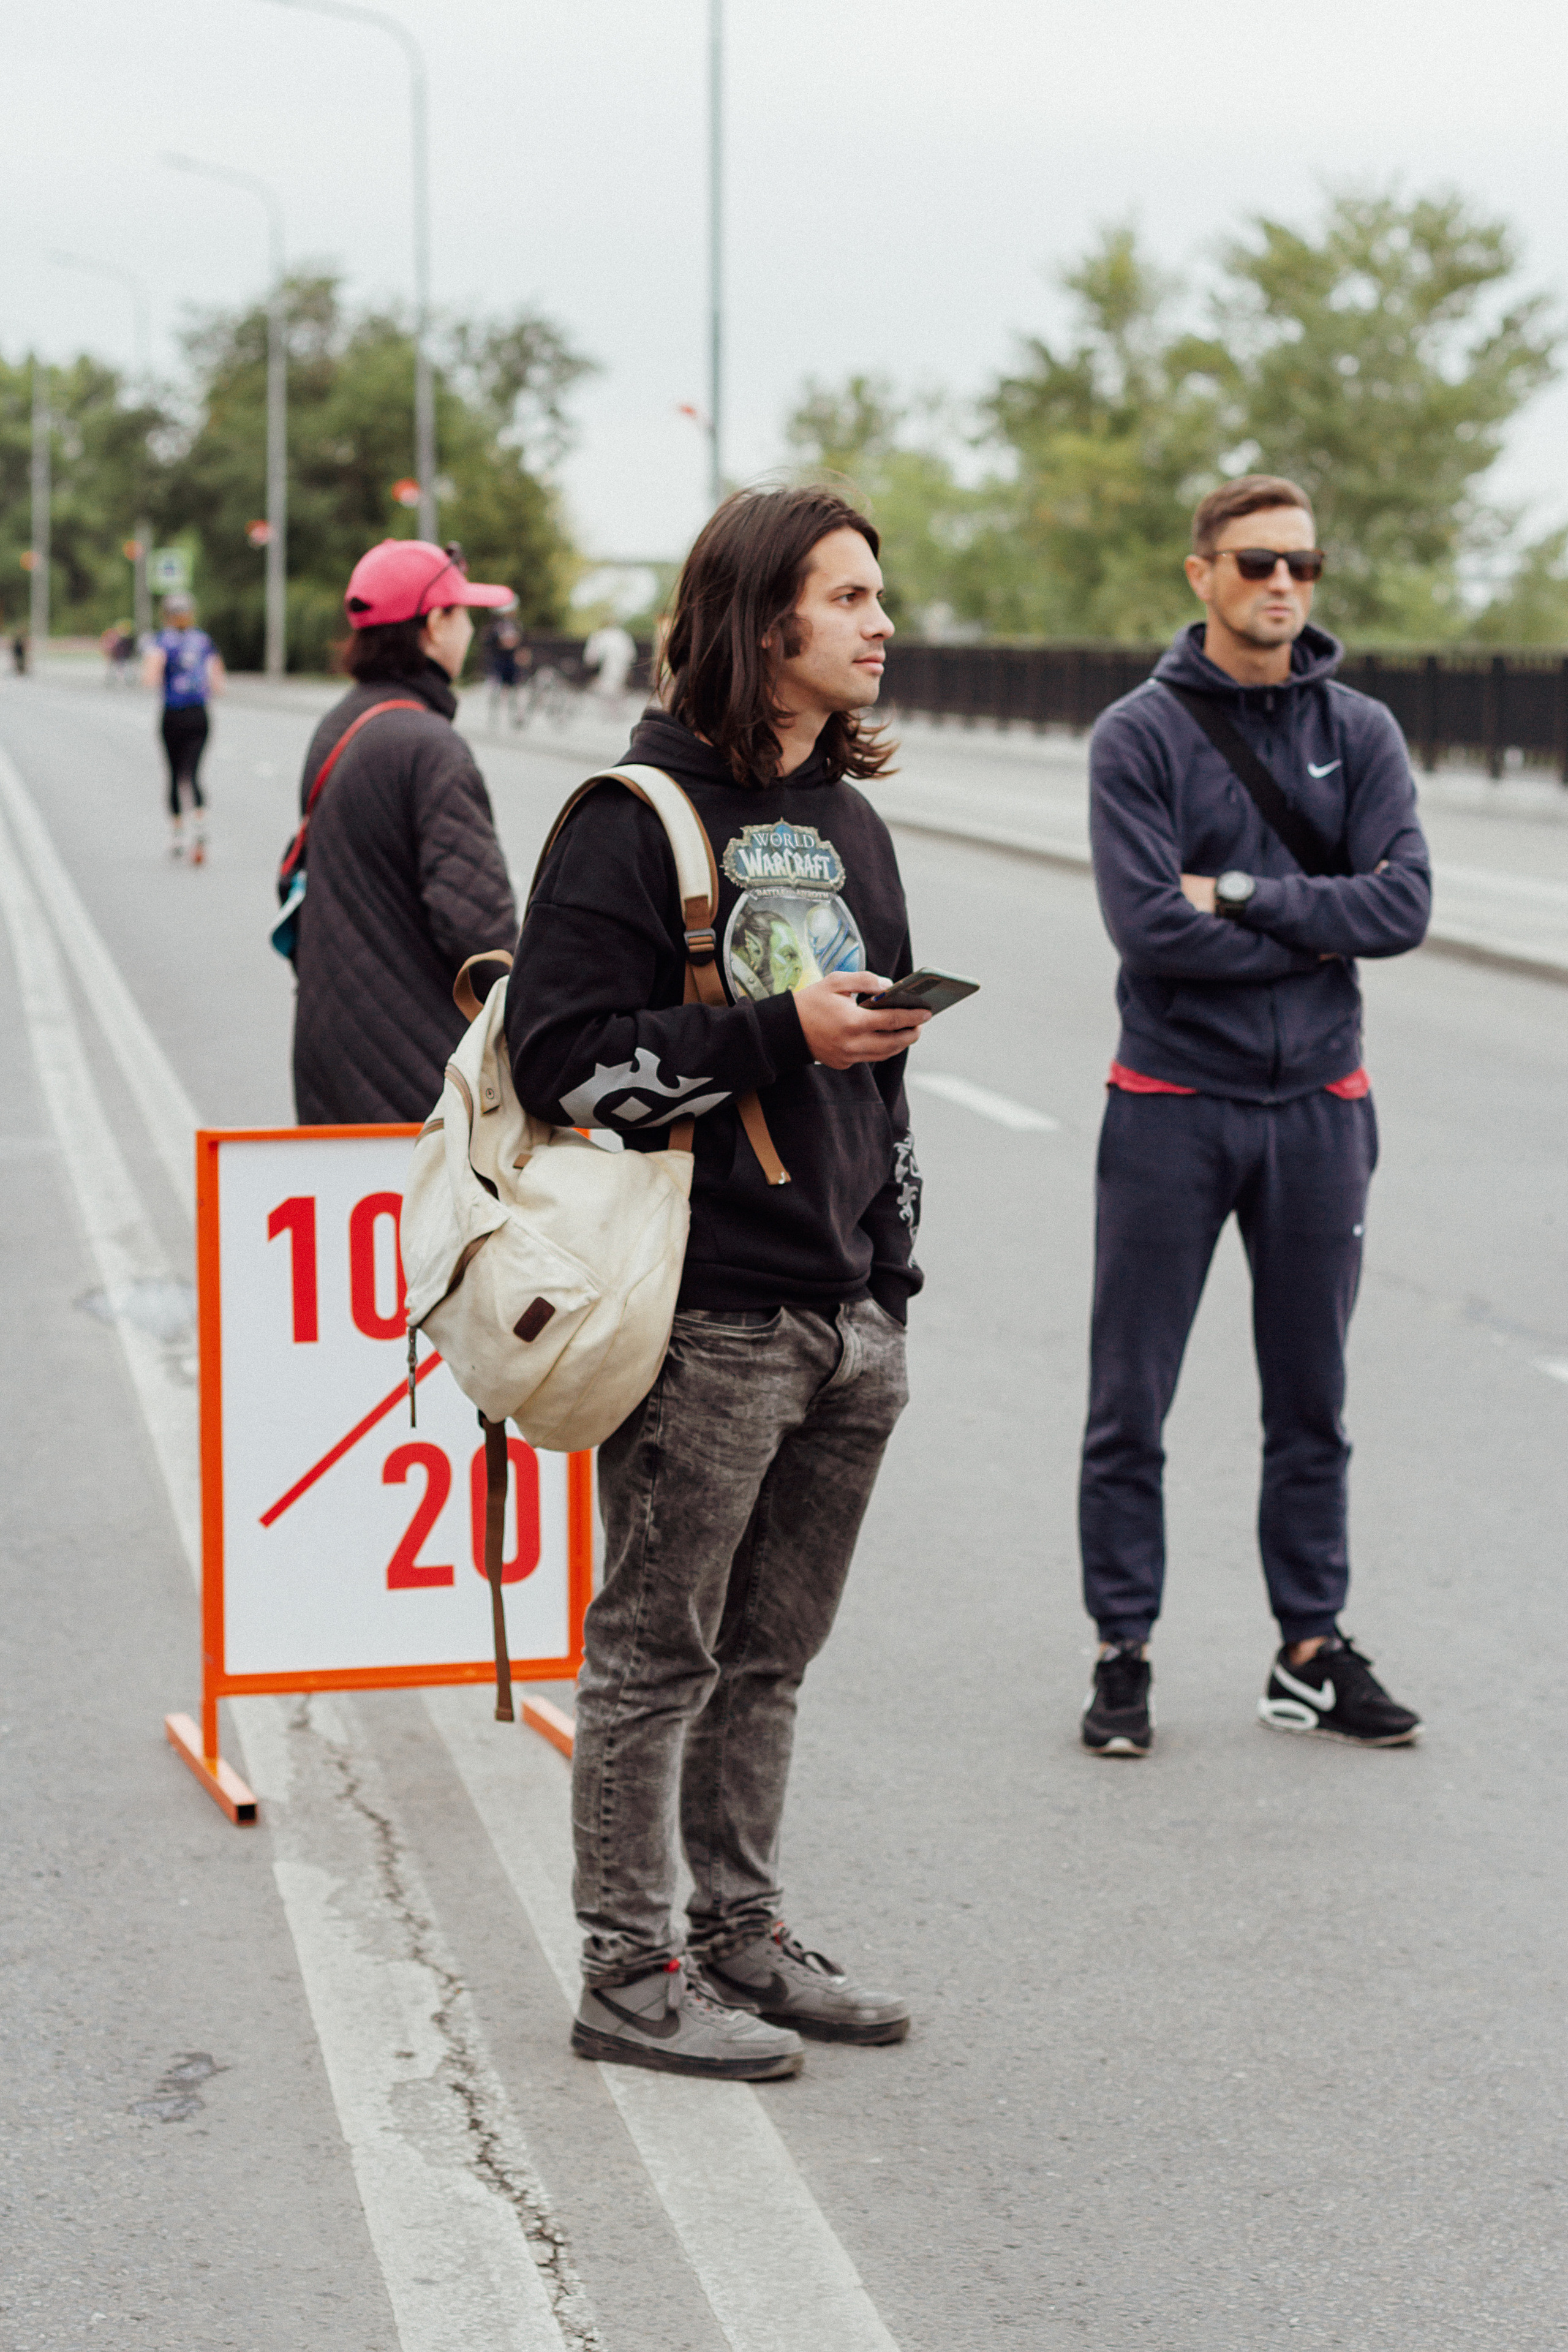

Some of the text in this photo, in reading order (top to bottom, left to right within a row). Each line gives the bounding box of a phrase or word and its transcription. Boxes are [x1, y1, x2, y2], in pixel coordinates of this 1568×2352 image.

[737, 848, 830, 881] WARCRAFT
[753, 833, 815, 848] WORLD
[268, 1191, 409, 1343] 10
[382, 1437, 541, 1590] 20
